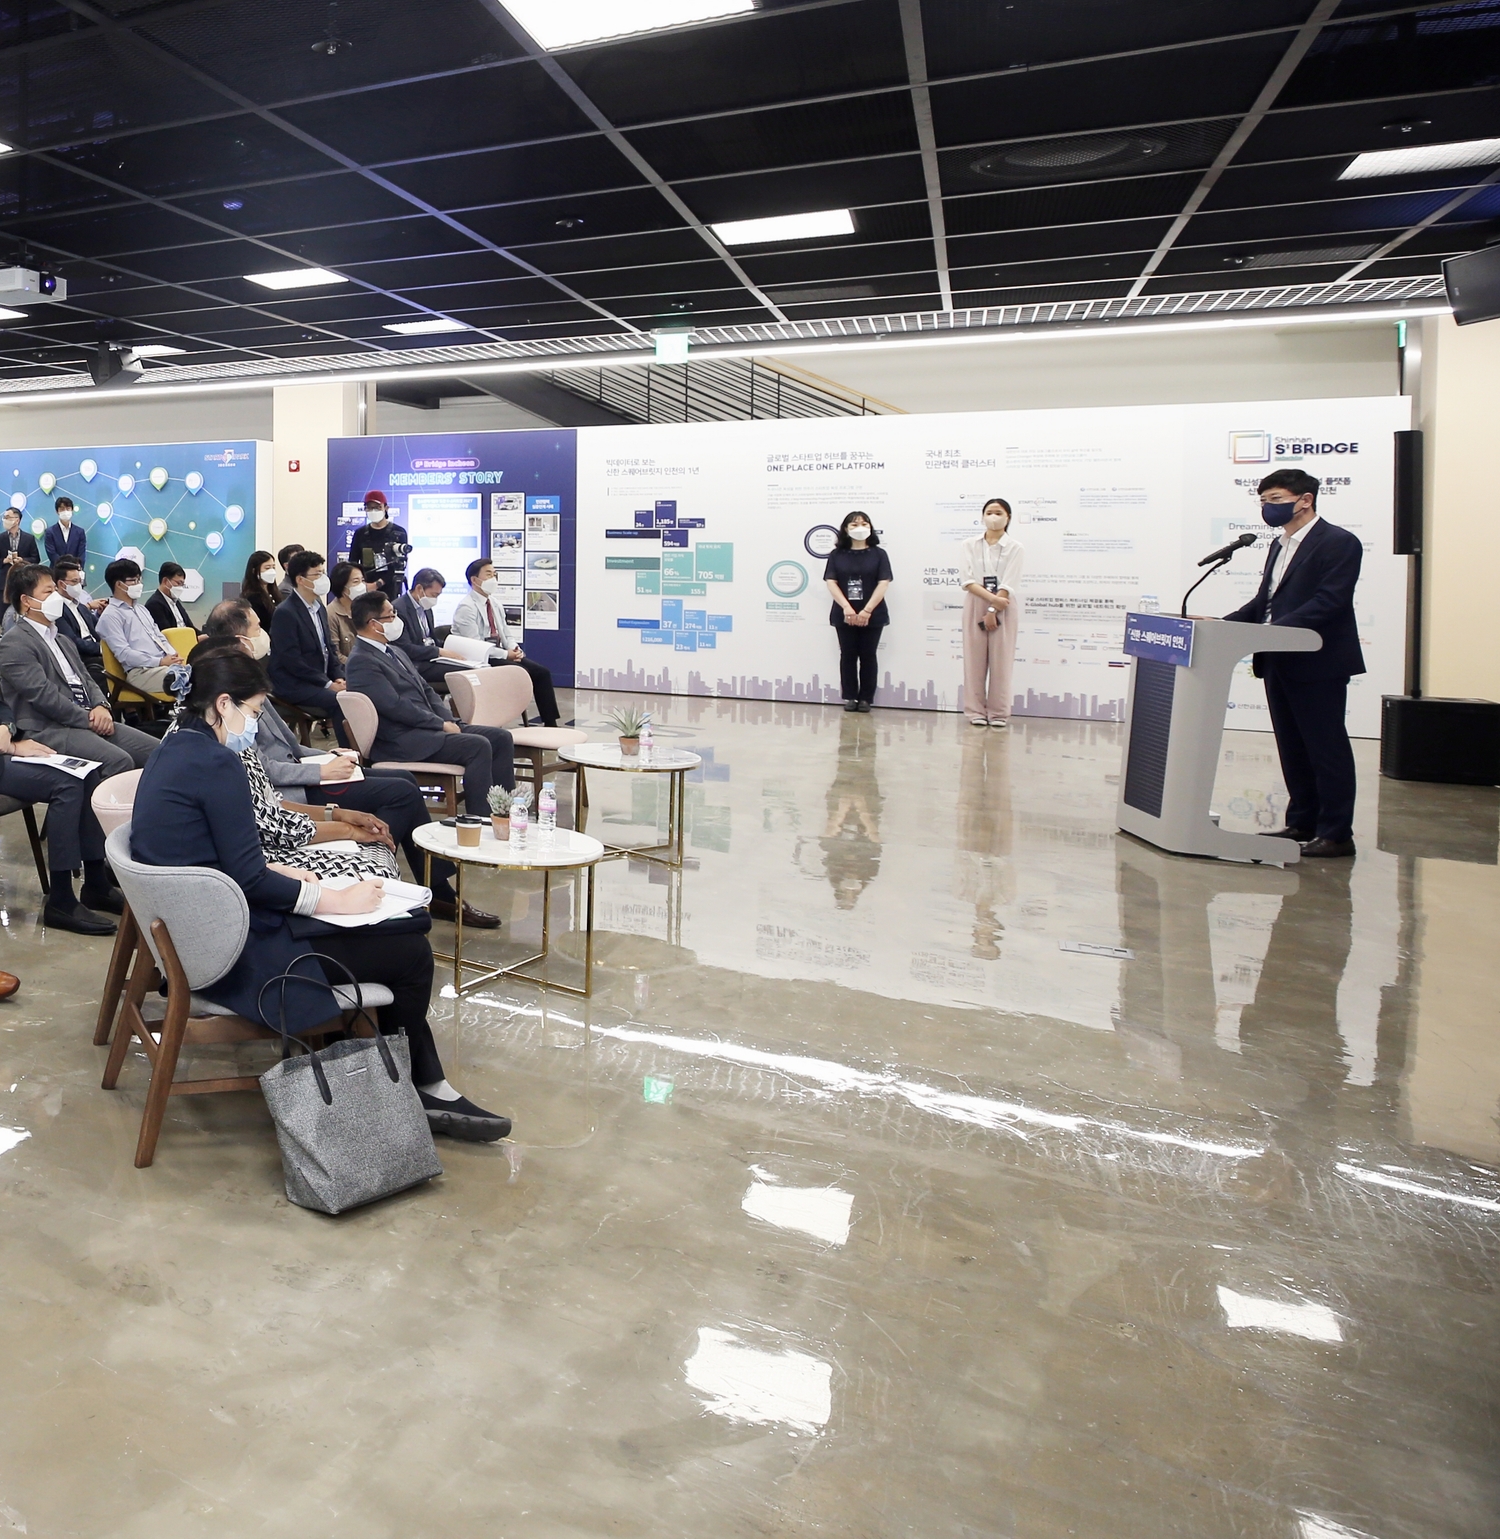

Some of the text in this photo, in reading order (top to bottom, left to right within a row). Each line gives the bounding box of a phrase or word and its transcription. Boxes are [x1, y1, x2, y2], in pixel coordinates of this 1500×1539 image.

[766, 451, 874, 462] 글로벌 스타트업 허브를 꿈꾸는
[925, 449, 961, 458] 국내 최초
[606, 458, 640, 467] 빅데이터로
[786, 464, 814, 472] PLACE
[836, 462, 885, 470] PLATFORM
[925, 458, 996, 469] 민관협력 클러스터
[606, 466, 700, 477] 신한 스퀘어브릿지 인천의 1년
[459, 470, 502, 484] STORY
[1325, 477, 1352, 486] 플랫폼
[1228, 523, 1276, 531] Dreaming
[698, 571, 714, 580] 705
[924, 568, 938, 576] 신한
[662, 620, 672, 628] 37
[1140, 632, 1172, 646] 스퀘어브릿지
